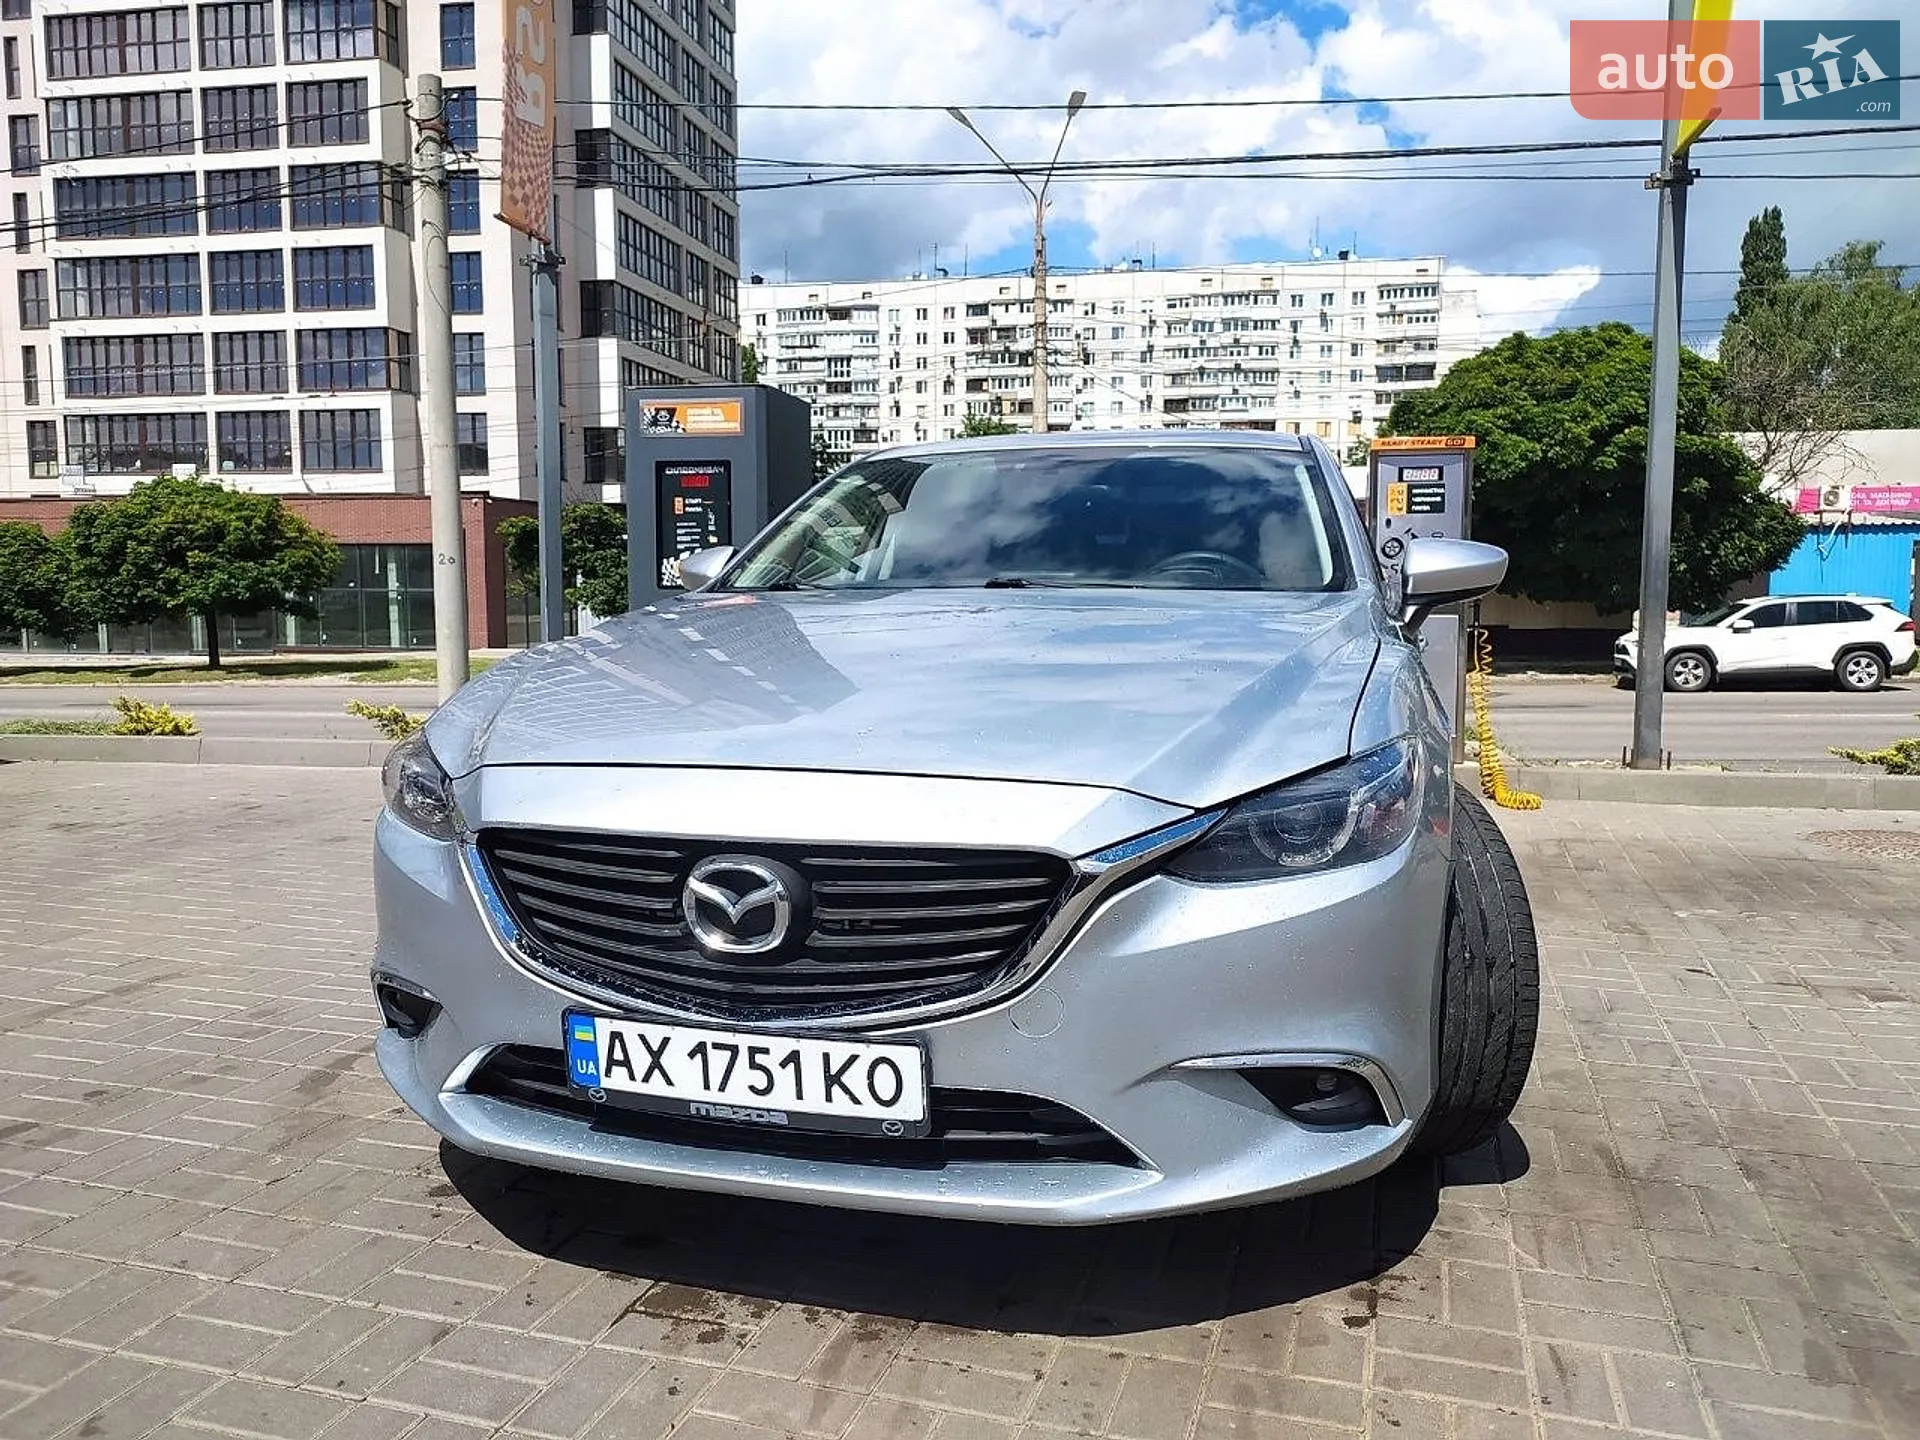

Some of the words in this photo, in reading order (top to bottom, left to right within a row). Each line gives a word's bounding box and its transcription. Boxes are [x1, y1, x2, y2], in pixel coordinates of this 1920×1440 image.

[1380, 439, 1409, 447] READY
[1411, 438, 1443, 446] STEADY
[577, 1059, 597, 1077] UA
[604, 1030, 676, 1088] AX
[687, 1041, 805, 1101] 1751
[822, 1051, 904, 1109] KO
